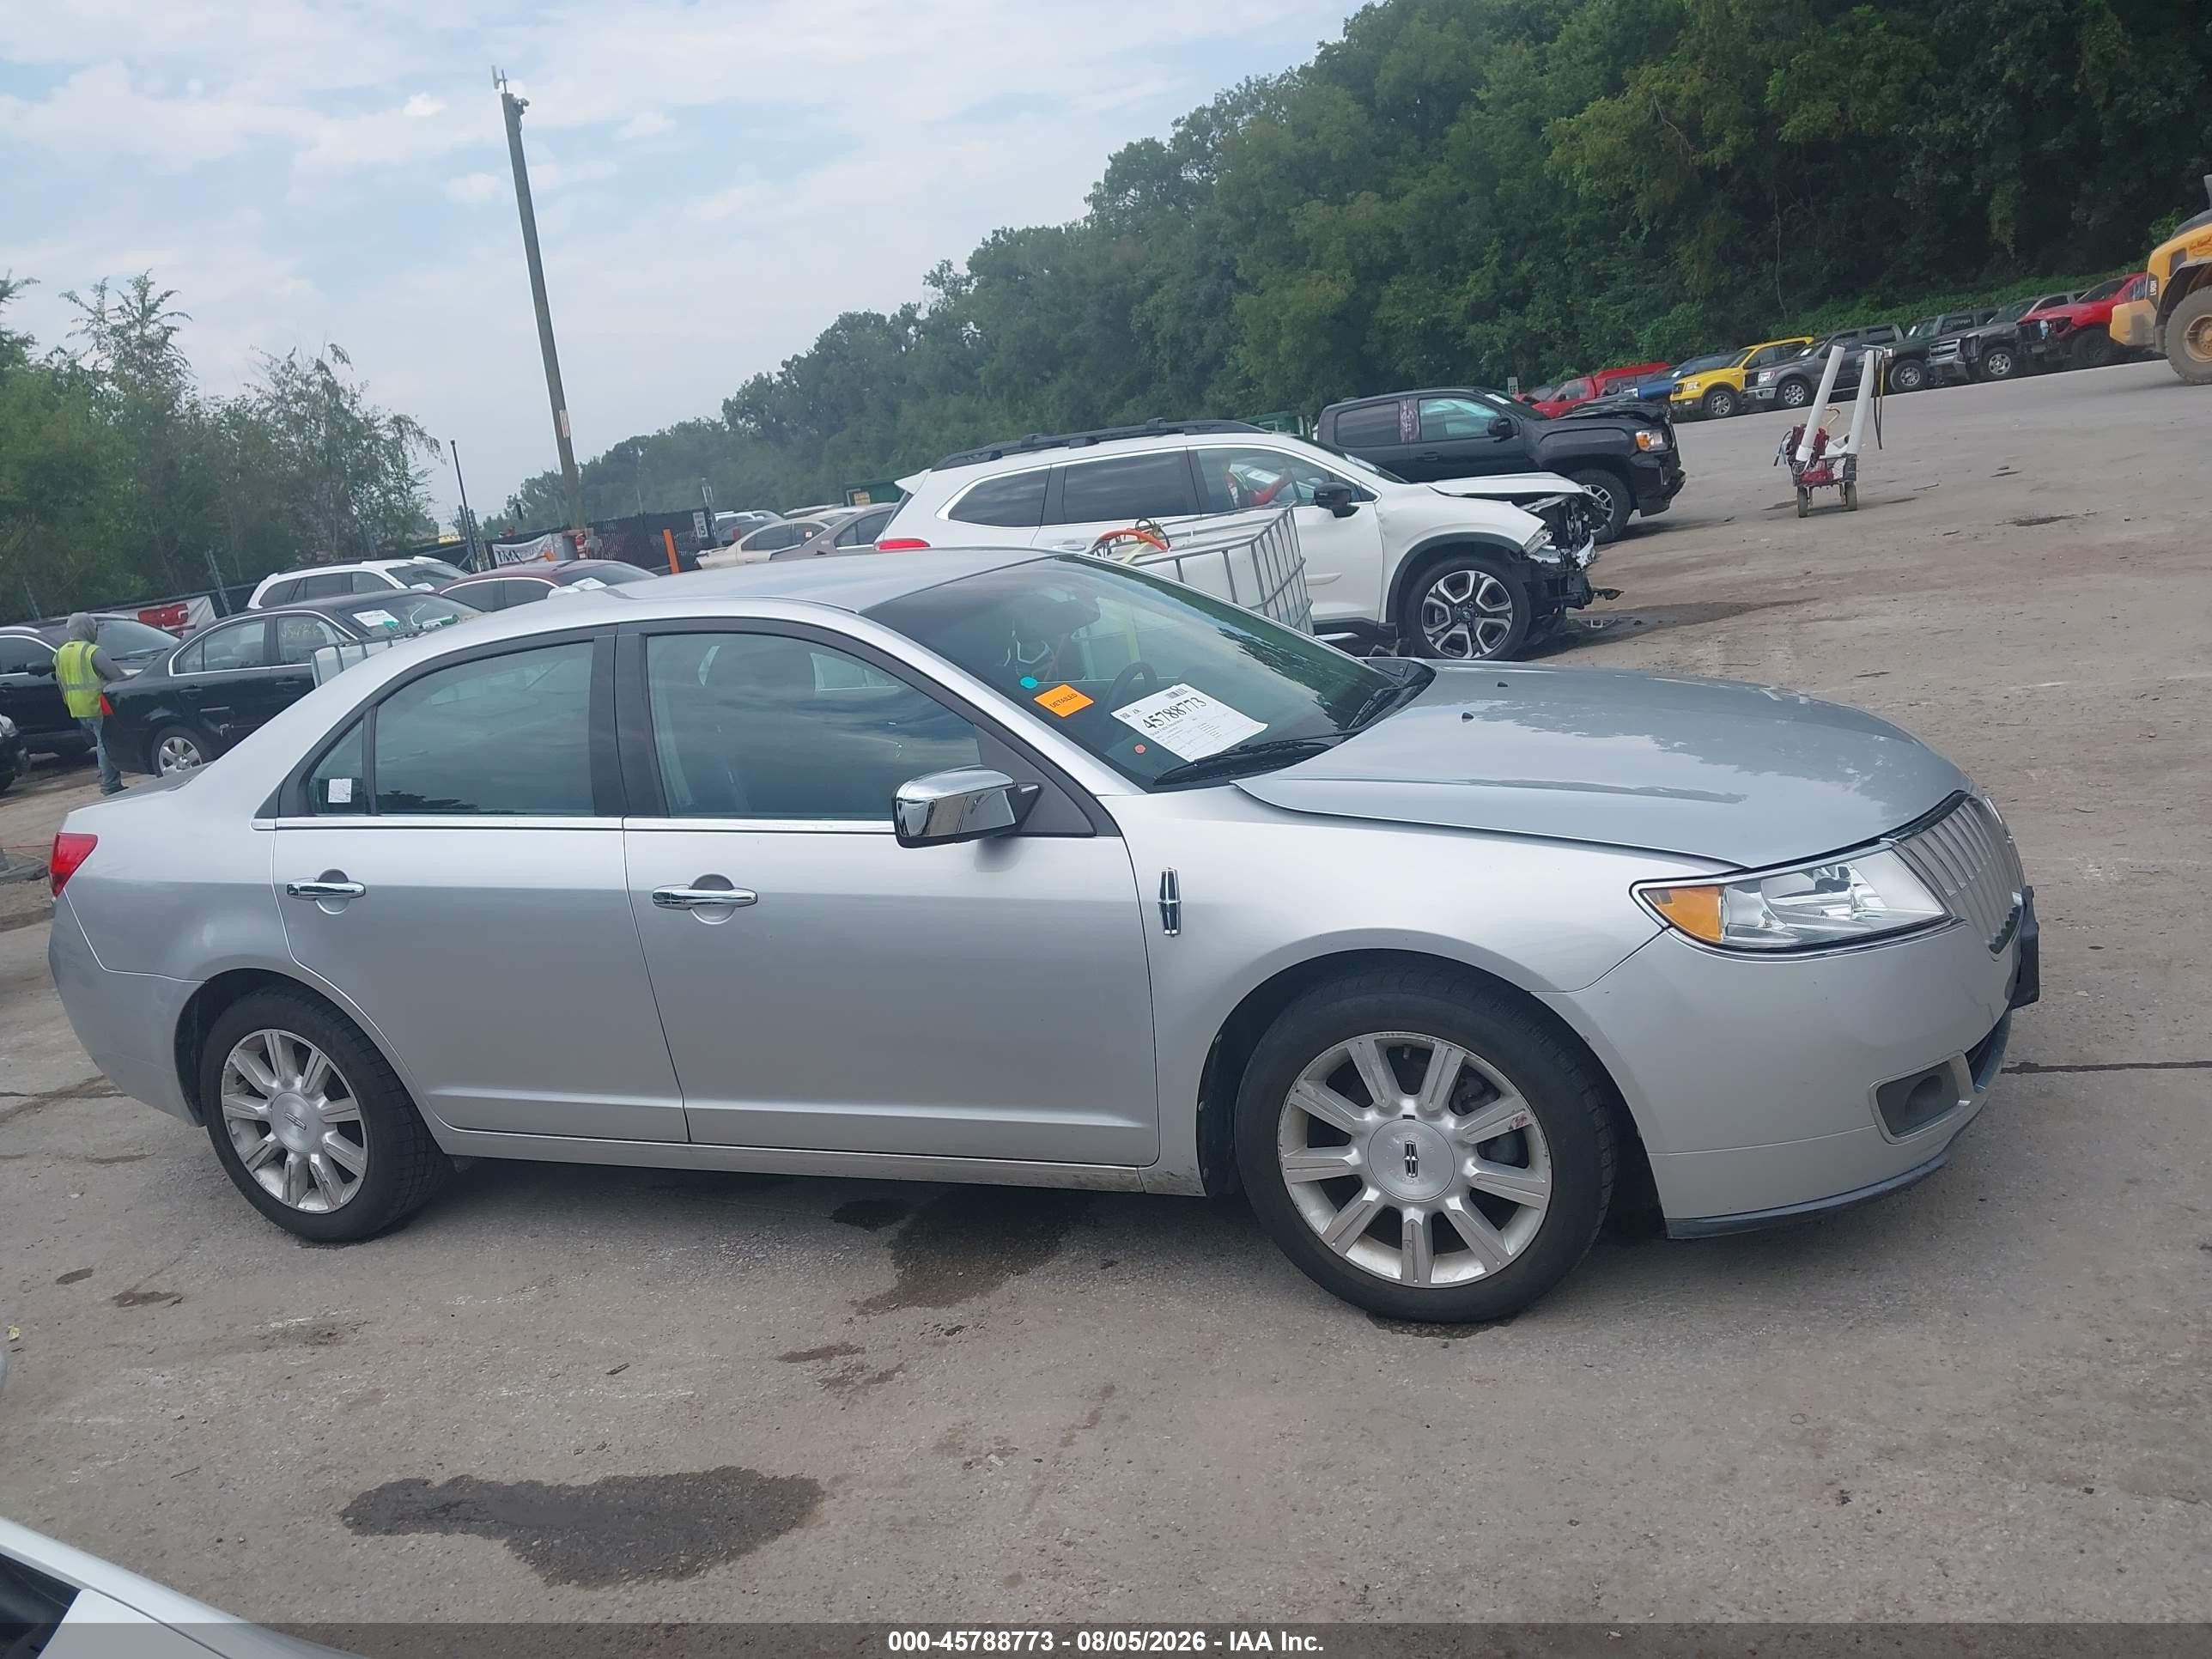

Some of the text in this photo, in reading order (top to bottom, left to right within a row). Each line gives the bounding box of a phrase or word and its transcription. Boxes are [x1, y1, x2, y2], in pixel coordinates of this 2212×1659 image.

[697, 524, 707, 537] 15
[1048, 692, 1079, 708] DETAILED
[1142, 696, 1207, 730] 45788773
